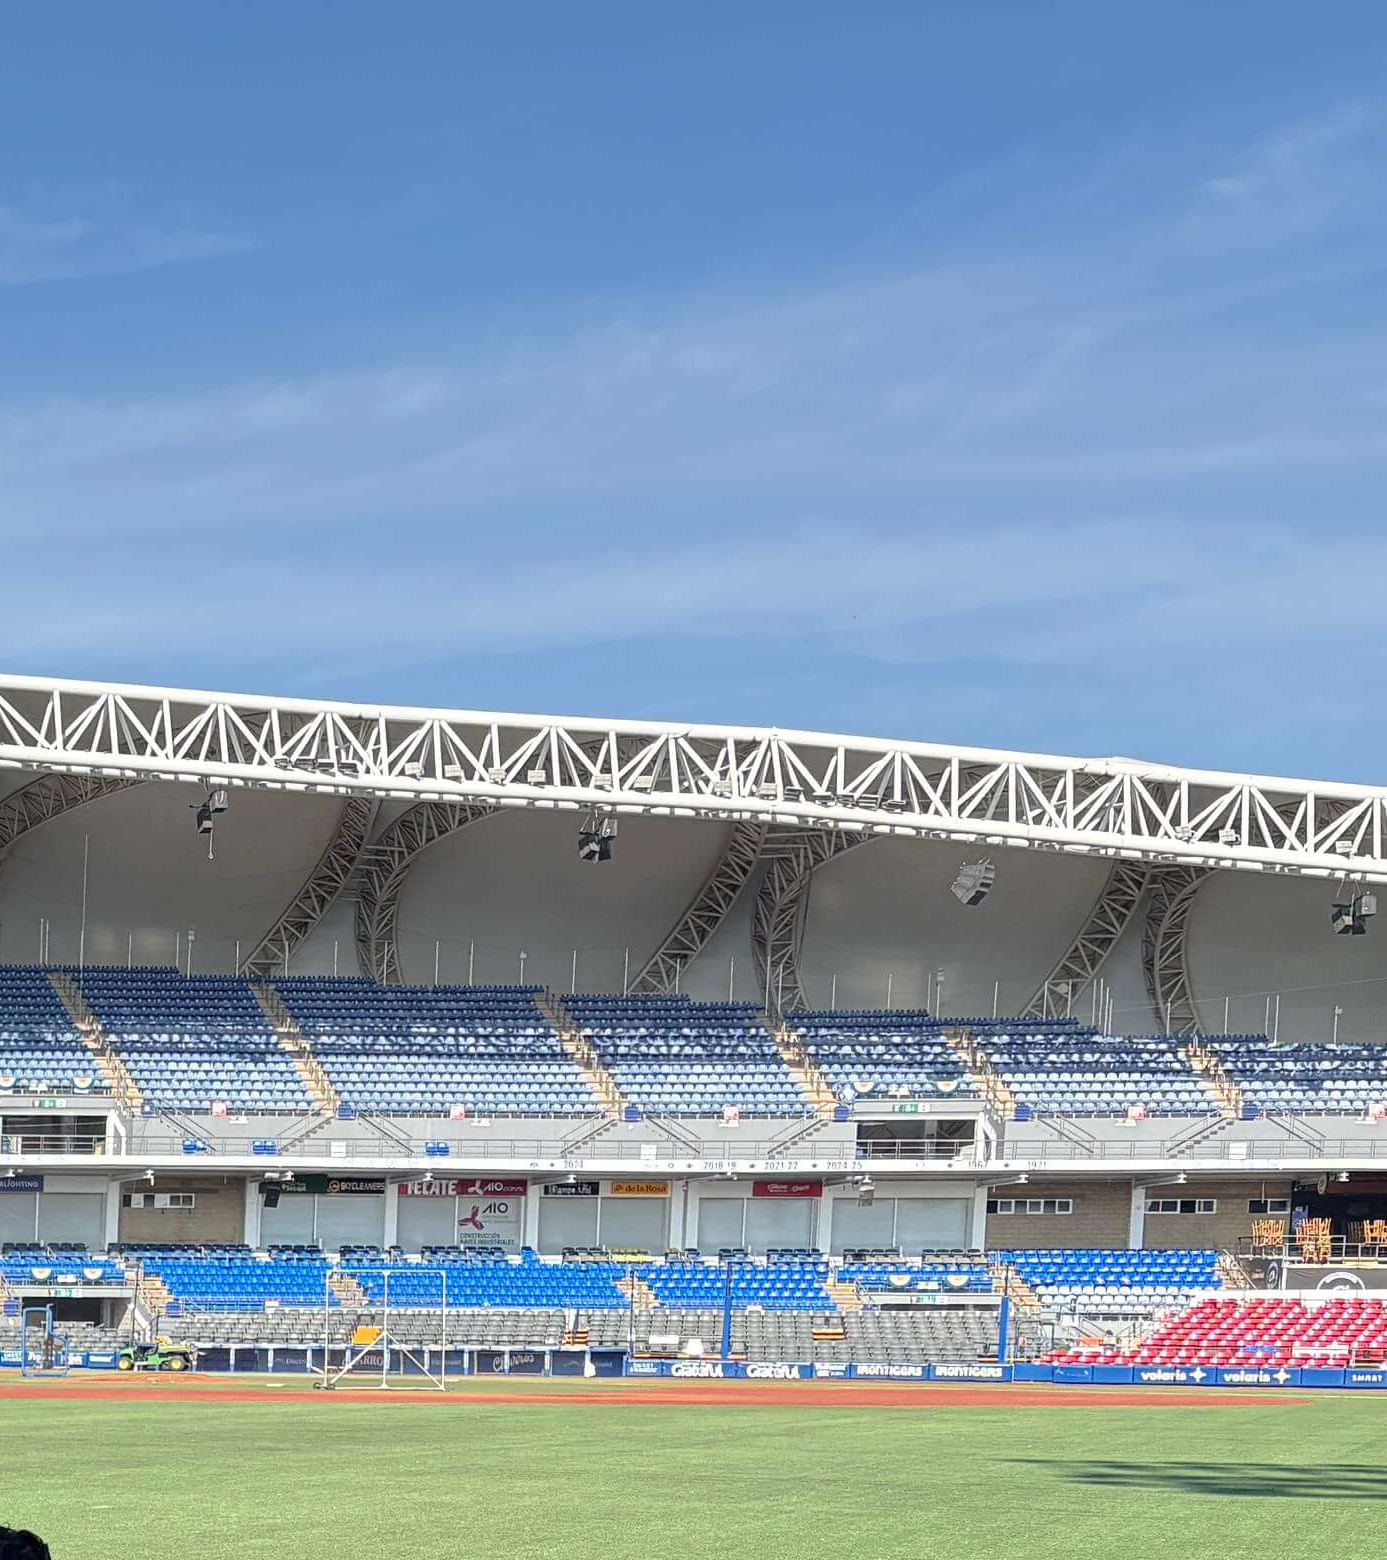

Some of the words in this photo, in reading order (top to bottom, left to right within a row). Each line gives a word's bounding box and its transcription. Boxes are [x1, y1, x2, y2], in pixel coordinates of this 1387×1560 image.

[408, 1180, 459, 1195] TECATE
[483, 1202, 508, 1213] AIO
[1141, 1370, 1187, 1382] volaris
[1223, 1371, 1270, 1383] volaris
[1351, 1374, 1383, 1382] SMART
